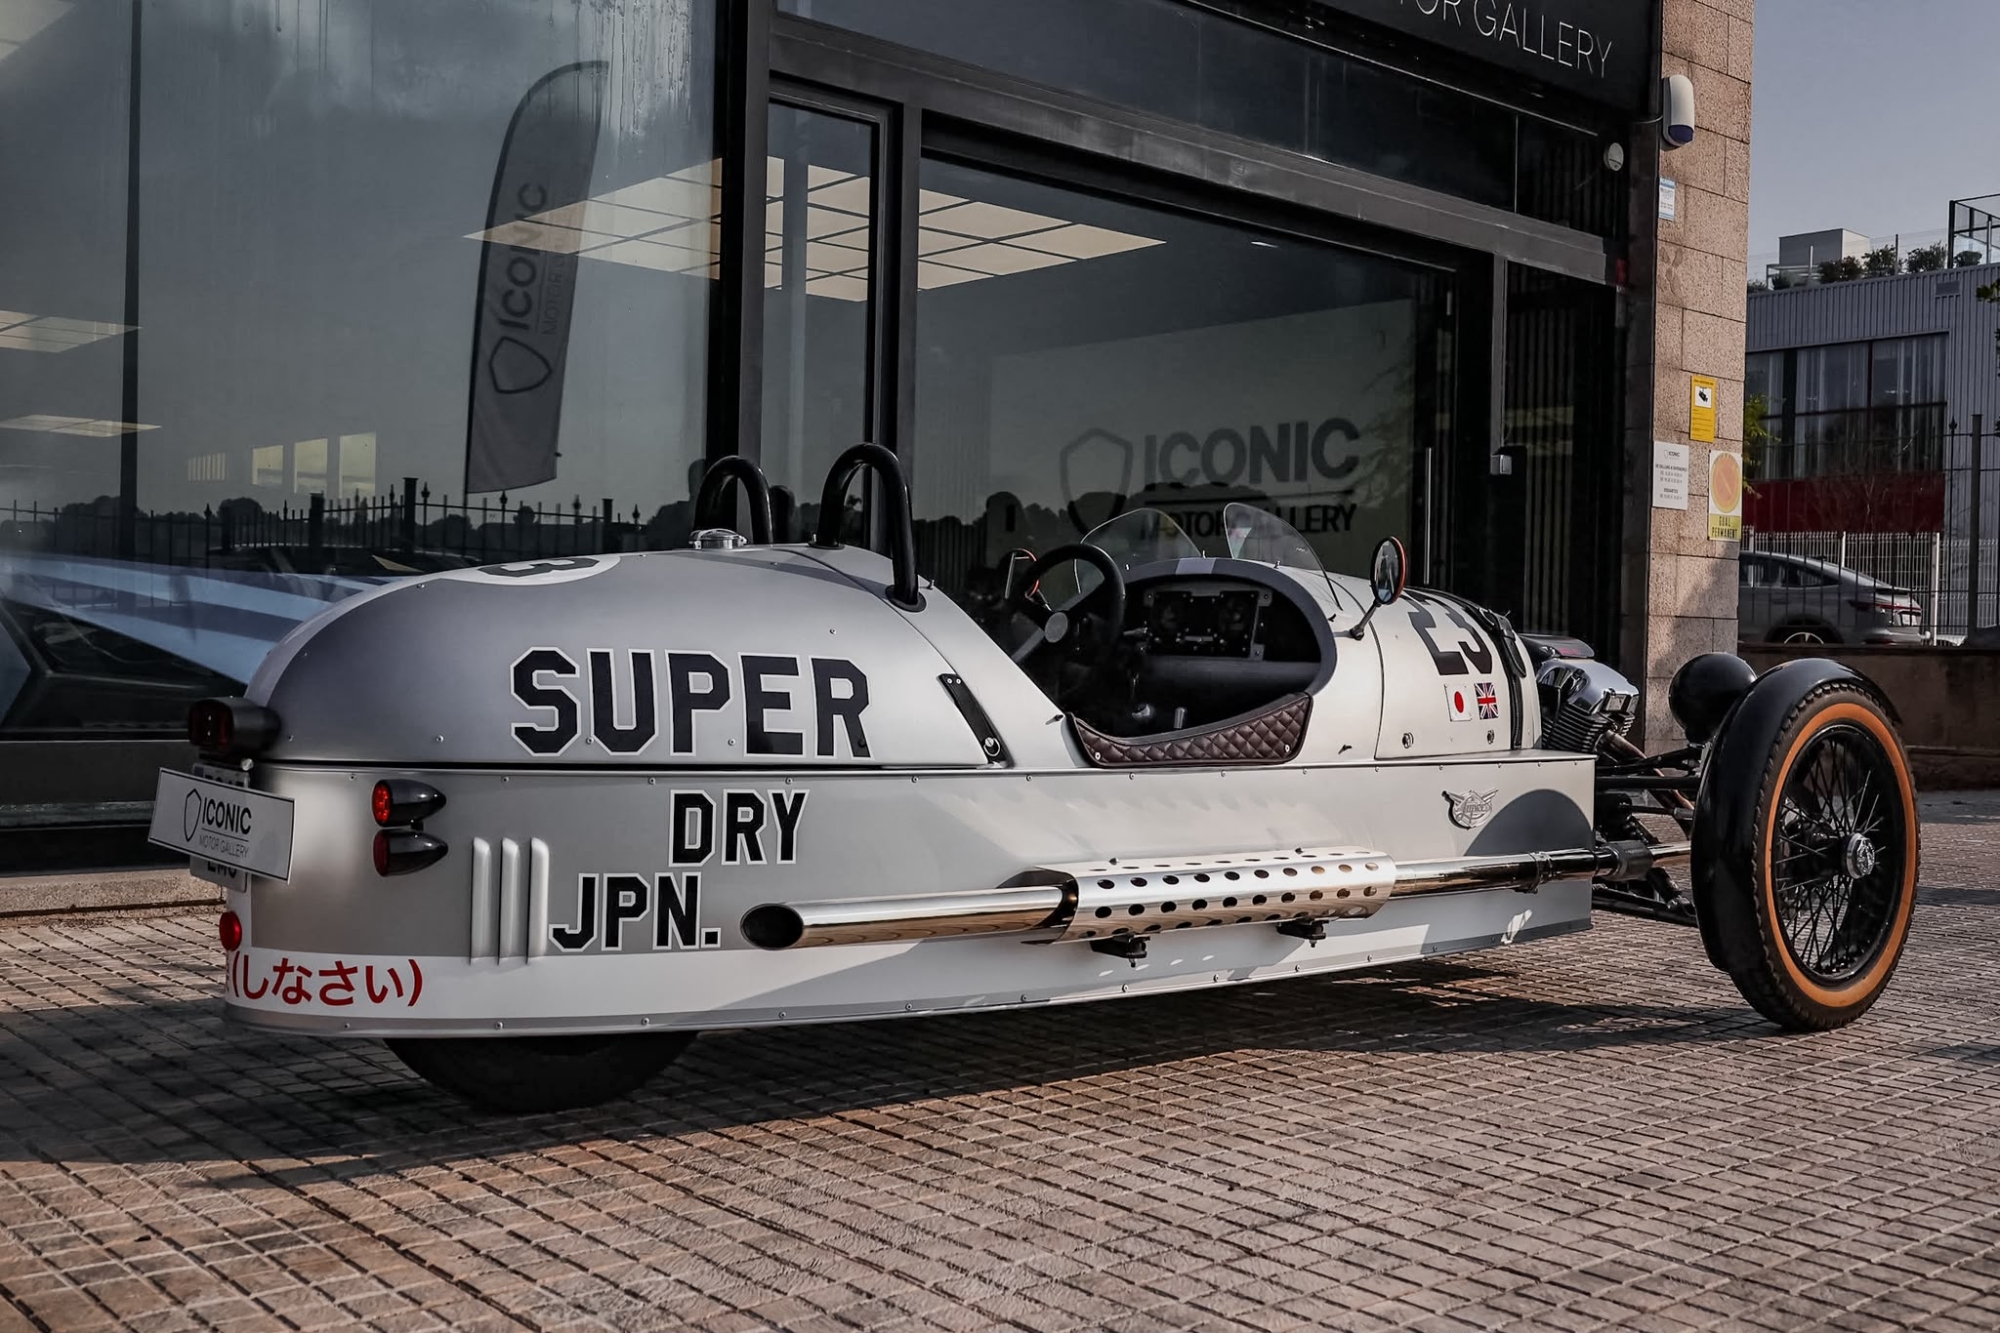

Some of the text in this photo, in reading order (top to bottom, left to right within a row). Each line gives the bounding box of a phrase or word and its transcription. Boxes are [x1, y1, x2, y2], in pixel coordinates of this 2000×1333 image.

[1473, 0, 1613, 78] GALLERY
[498, 183, 547, 331] ICONIC
[1144, 418, 1361, 491] ICONIC
[1399, 588, 1493, 676] 23
[510, 646, 873, 758] SUPER
[199, 833, 250, 860] MOTOR GALLERY
[202, 797, 252, 835] ICONIC
[668, 789, 810, 866] DRY
[549, 872, 721, 952] JPN.
[232, 951, 423, 1007] (しなさい)
